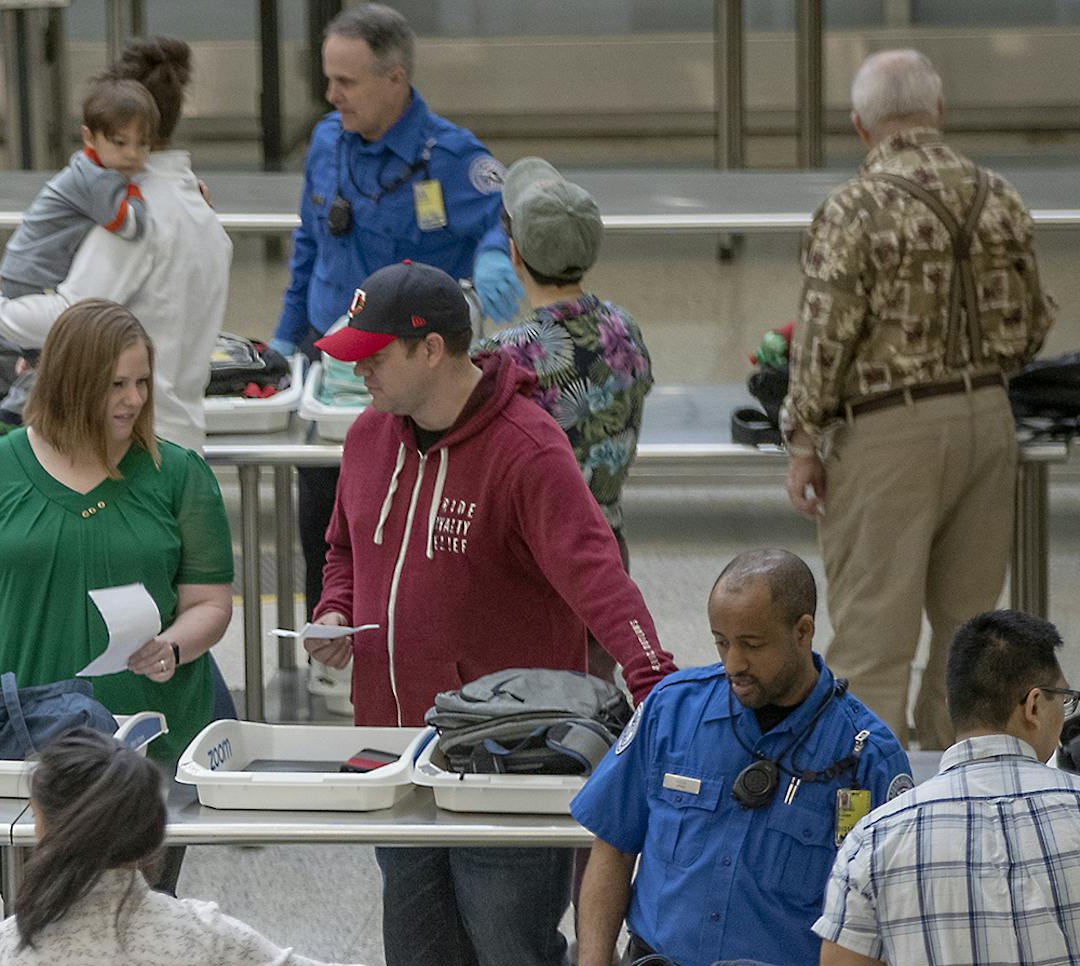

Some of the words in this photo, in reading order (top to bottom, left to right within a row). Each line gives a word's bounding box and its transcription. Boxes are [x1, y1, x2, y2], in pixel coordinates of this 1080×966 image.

[442, 497, 477, 518] RIDE
[435, 516, 471, 536] YALTY
[433, 535, 468, 553] ELIEF
[207, 738, 232, 771] zoom
